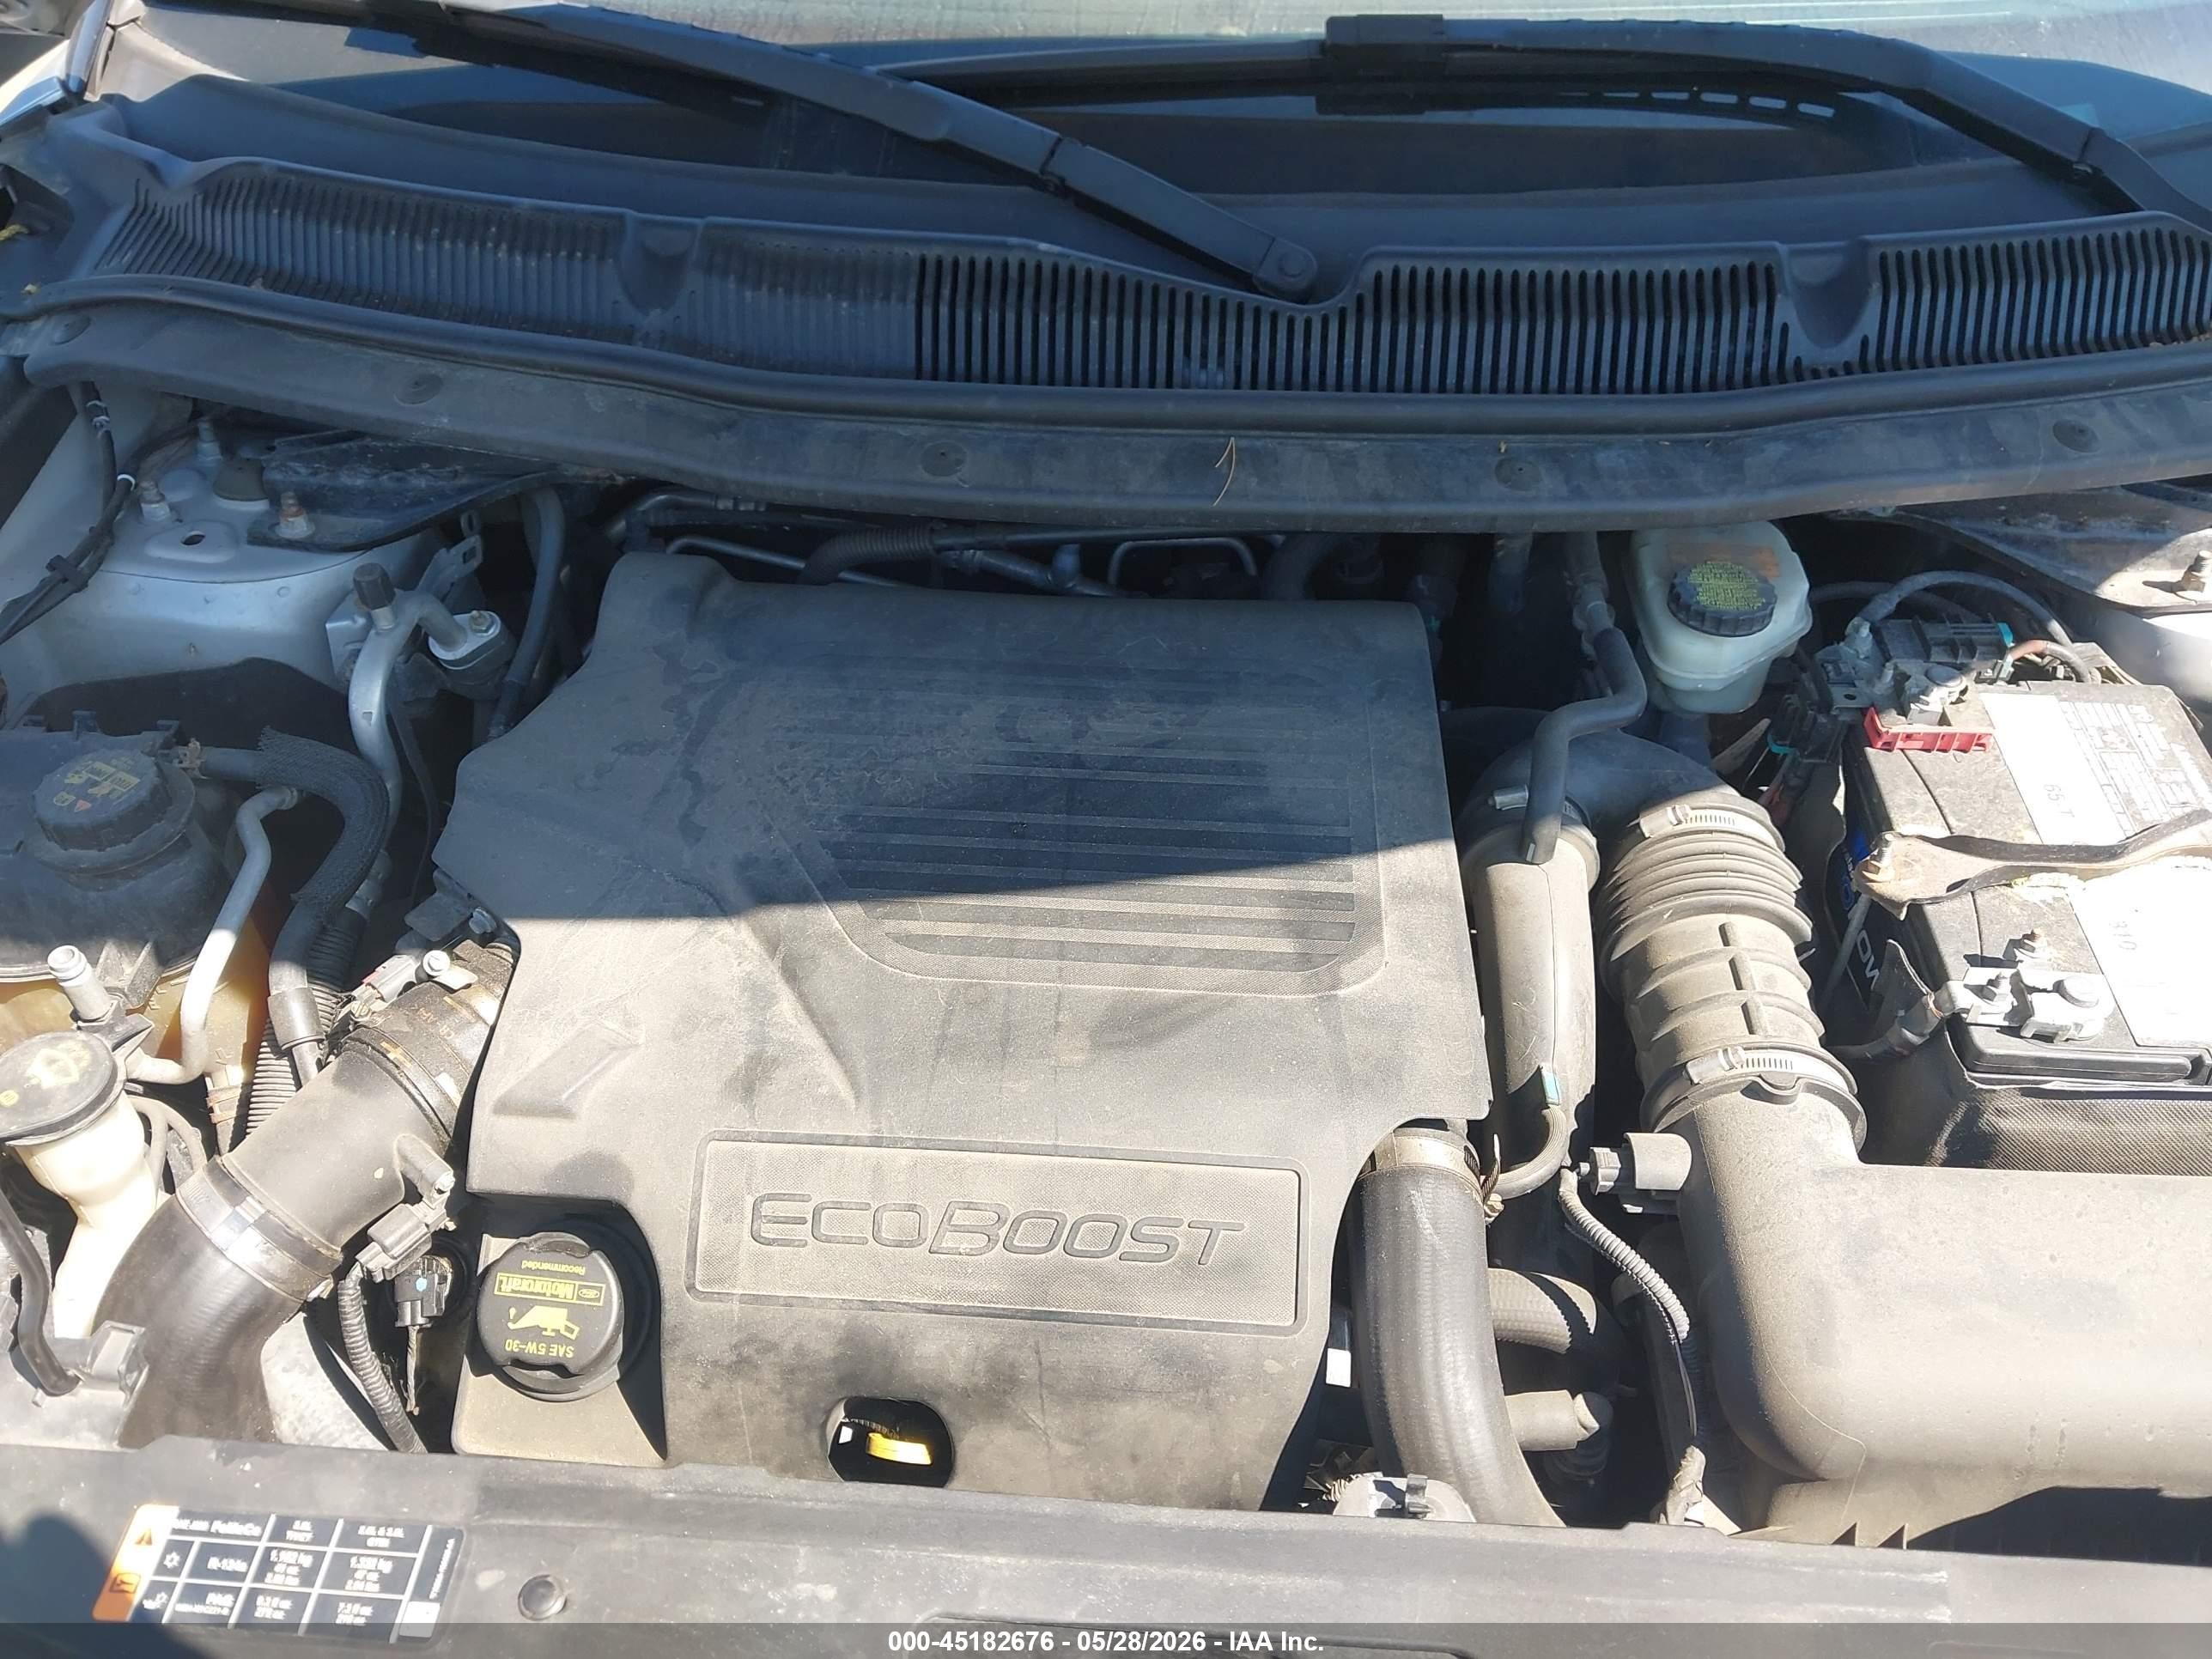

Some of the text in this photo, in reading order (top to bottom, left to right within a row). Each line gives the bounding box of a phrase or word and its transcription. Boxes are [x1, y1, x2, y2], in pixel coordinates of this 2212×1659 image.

[521, 1260, 586, 1276] Recommended
[500, 1276, 574, 1299] Motorcraft
[505, 1339, 574, 1358] SAE 5W-30
